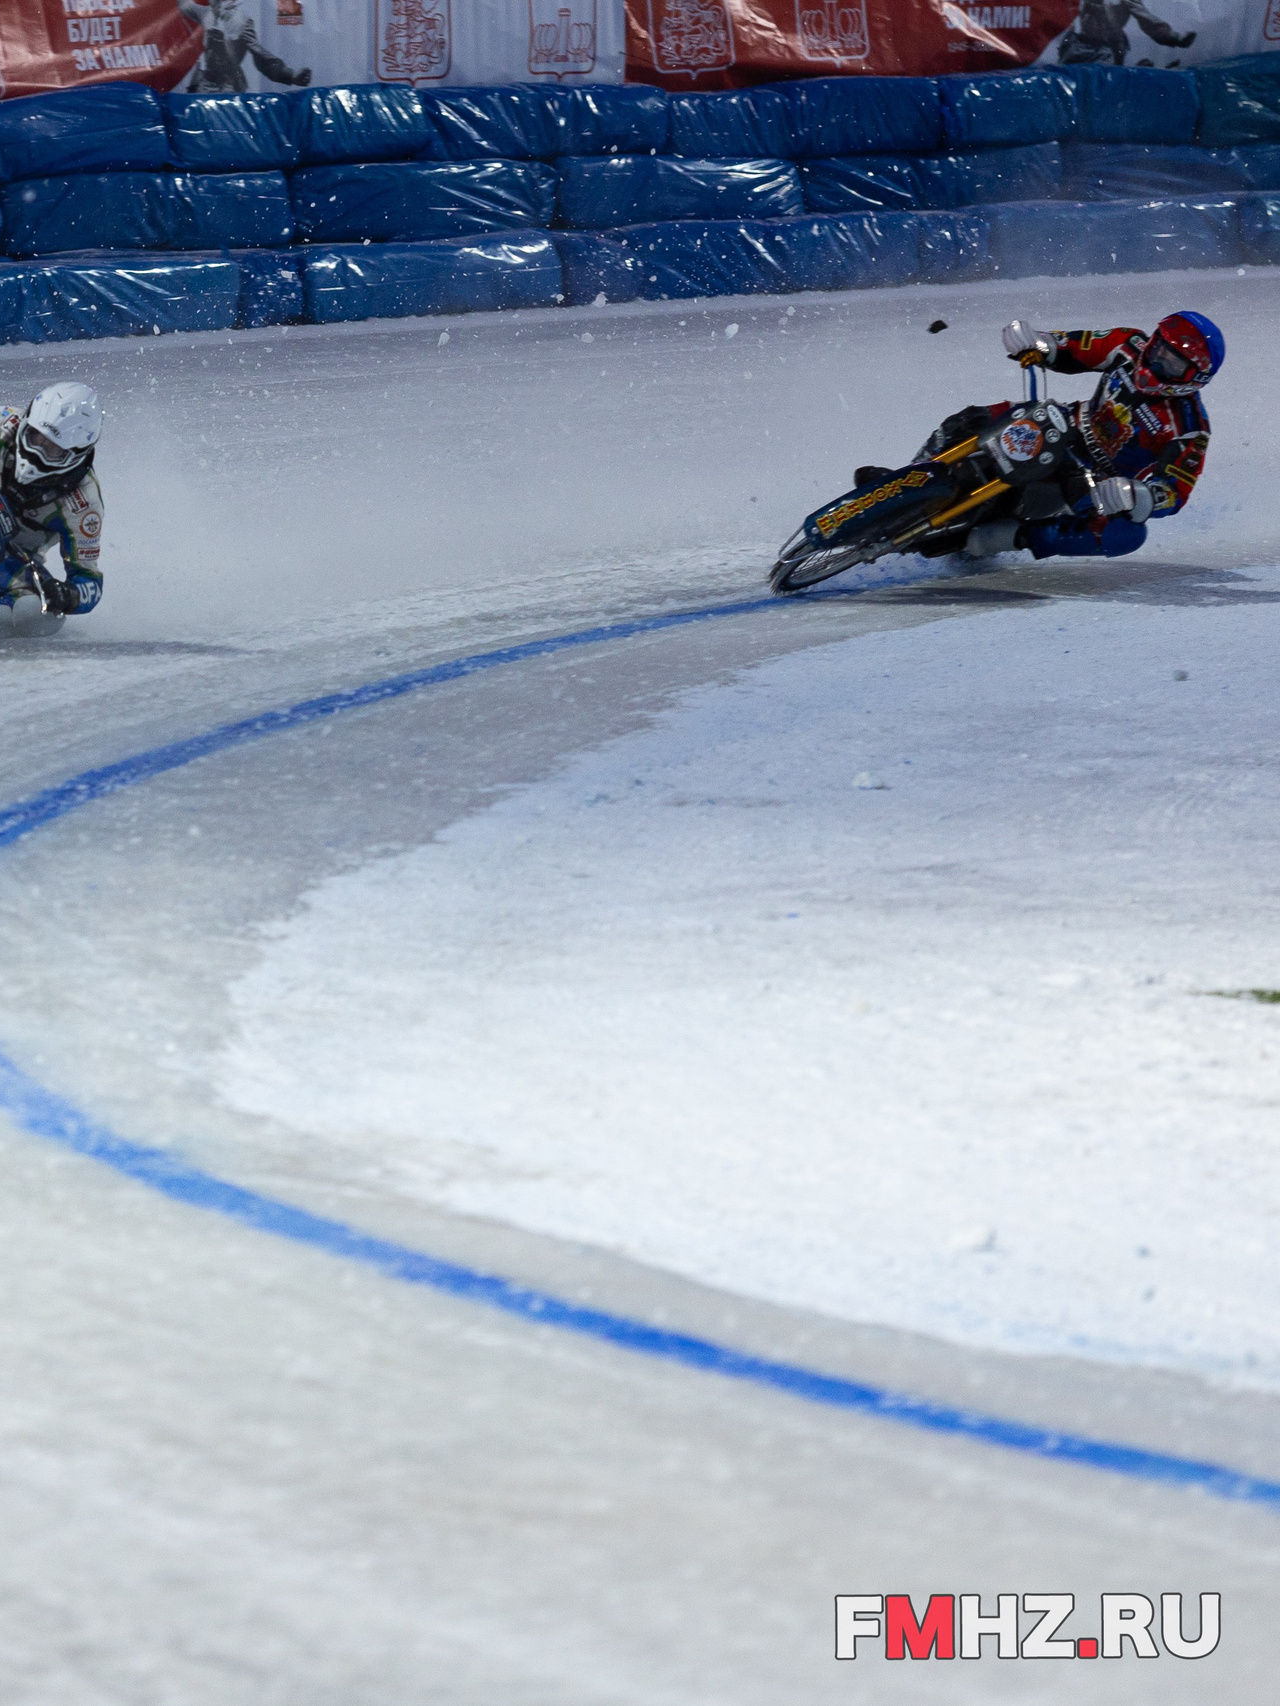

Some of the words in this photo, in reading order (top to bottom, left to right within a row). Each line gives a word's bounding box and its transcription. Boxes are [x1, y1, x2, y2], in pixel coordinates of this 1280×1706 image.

[66, 16, 122, 45] БУДЕТ
[71, 47, 101, 71] ЗА
[100, 43, 163, 69] НАМИ!
